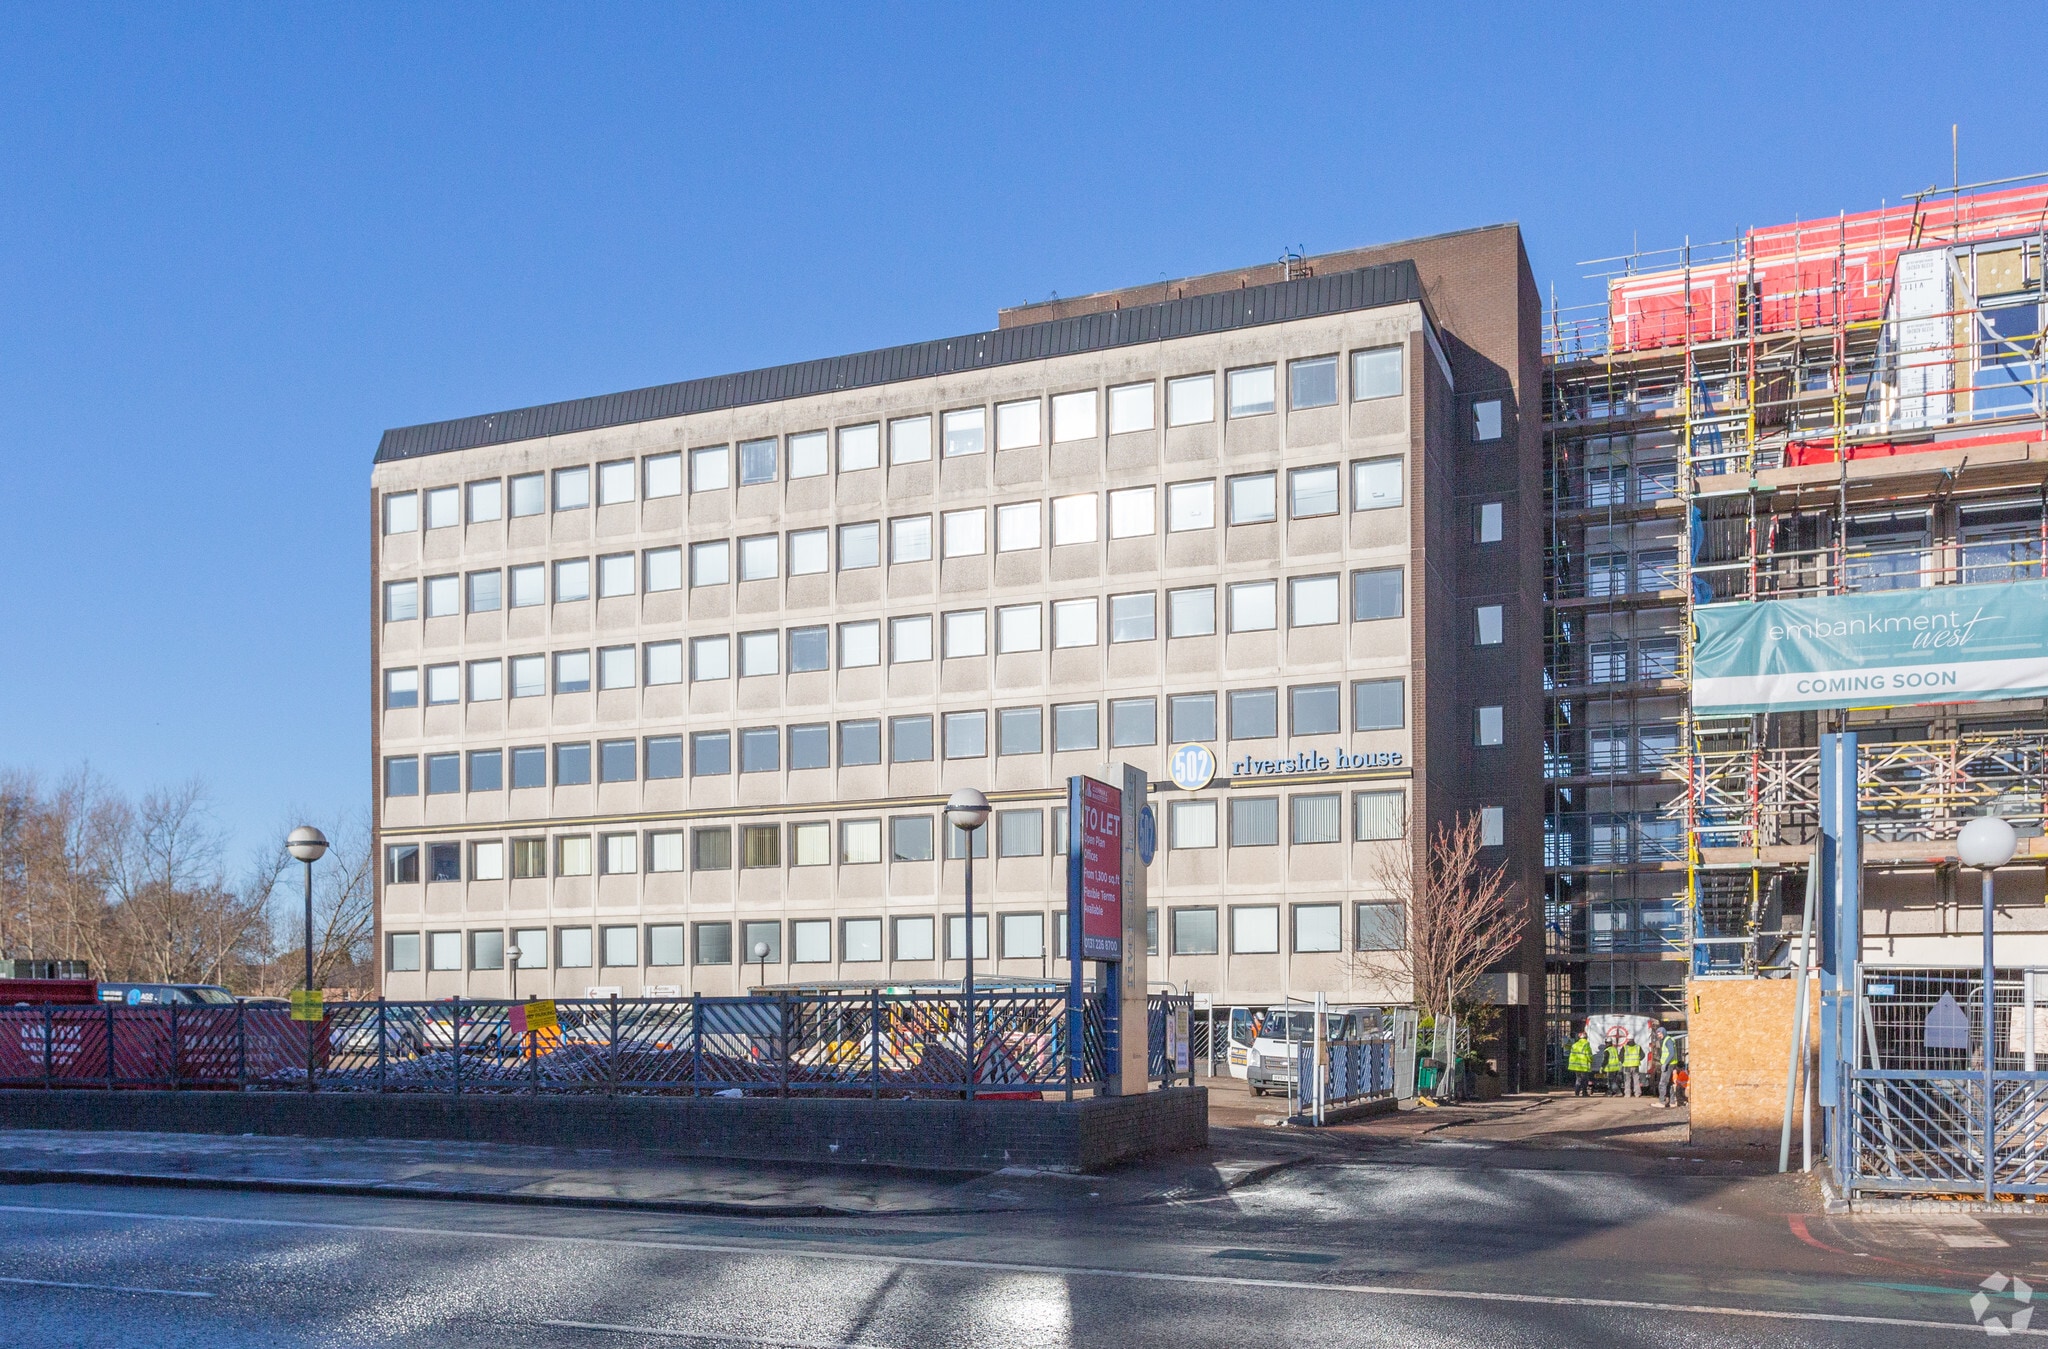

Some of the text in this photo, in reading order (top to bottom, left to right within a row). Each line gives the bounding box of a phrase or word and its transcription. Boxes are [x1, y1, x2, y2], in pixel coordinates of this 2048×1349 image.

[1769, 610, 1960, 642] embankment
[1912, 607, 2006, 650] west
[1796, 670, 1957, 694] COMING SOON
[1175, 749, 1209, 783] 502
[1232, 746, 1403, 776] riverside house
[1085, 805, 1120, 837] TO LET
[1084, 832, 1106, 849] Open Plan
[1084, 867, 1095, 879] From
[1084, 887, 1116, 903] Flexible Terms
[1084, 903, 1104, 916] Available
[1096, 939, 1105, 950] 226
